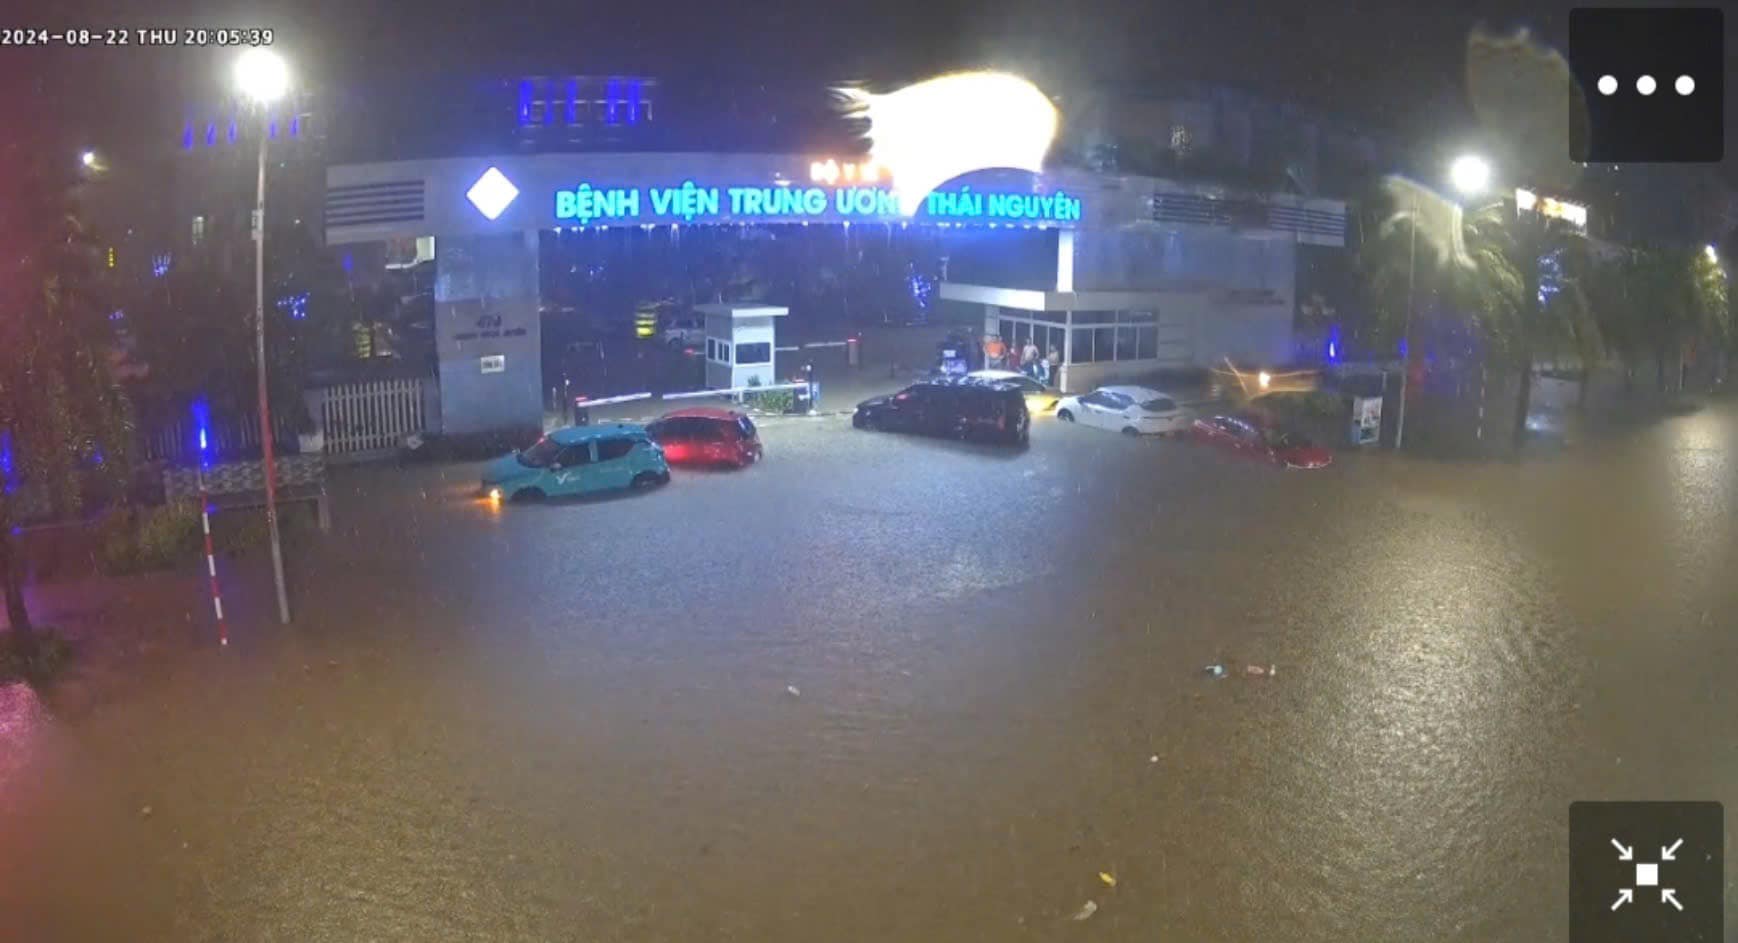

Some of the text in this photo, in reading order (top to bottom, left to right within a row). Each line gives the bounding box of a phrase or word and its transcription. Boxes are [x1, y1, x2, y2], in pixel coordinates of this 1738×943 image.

[556, 181, 1081, 224] BỆNH VIỆN TRUNG ƯƠN THÁI NGUYÊN
